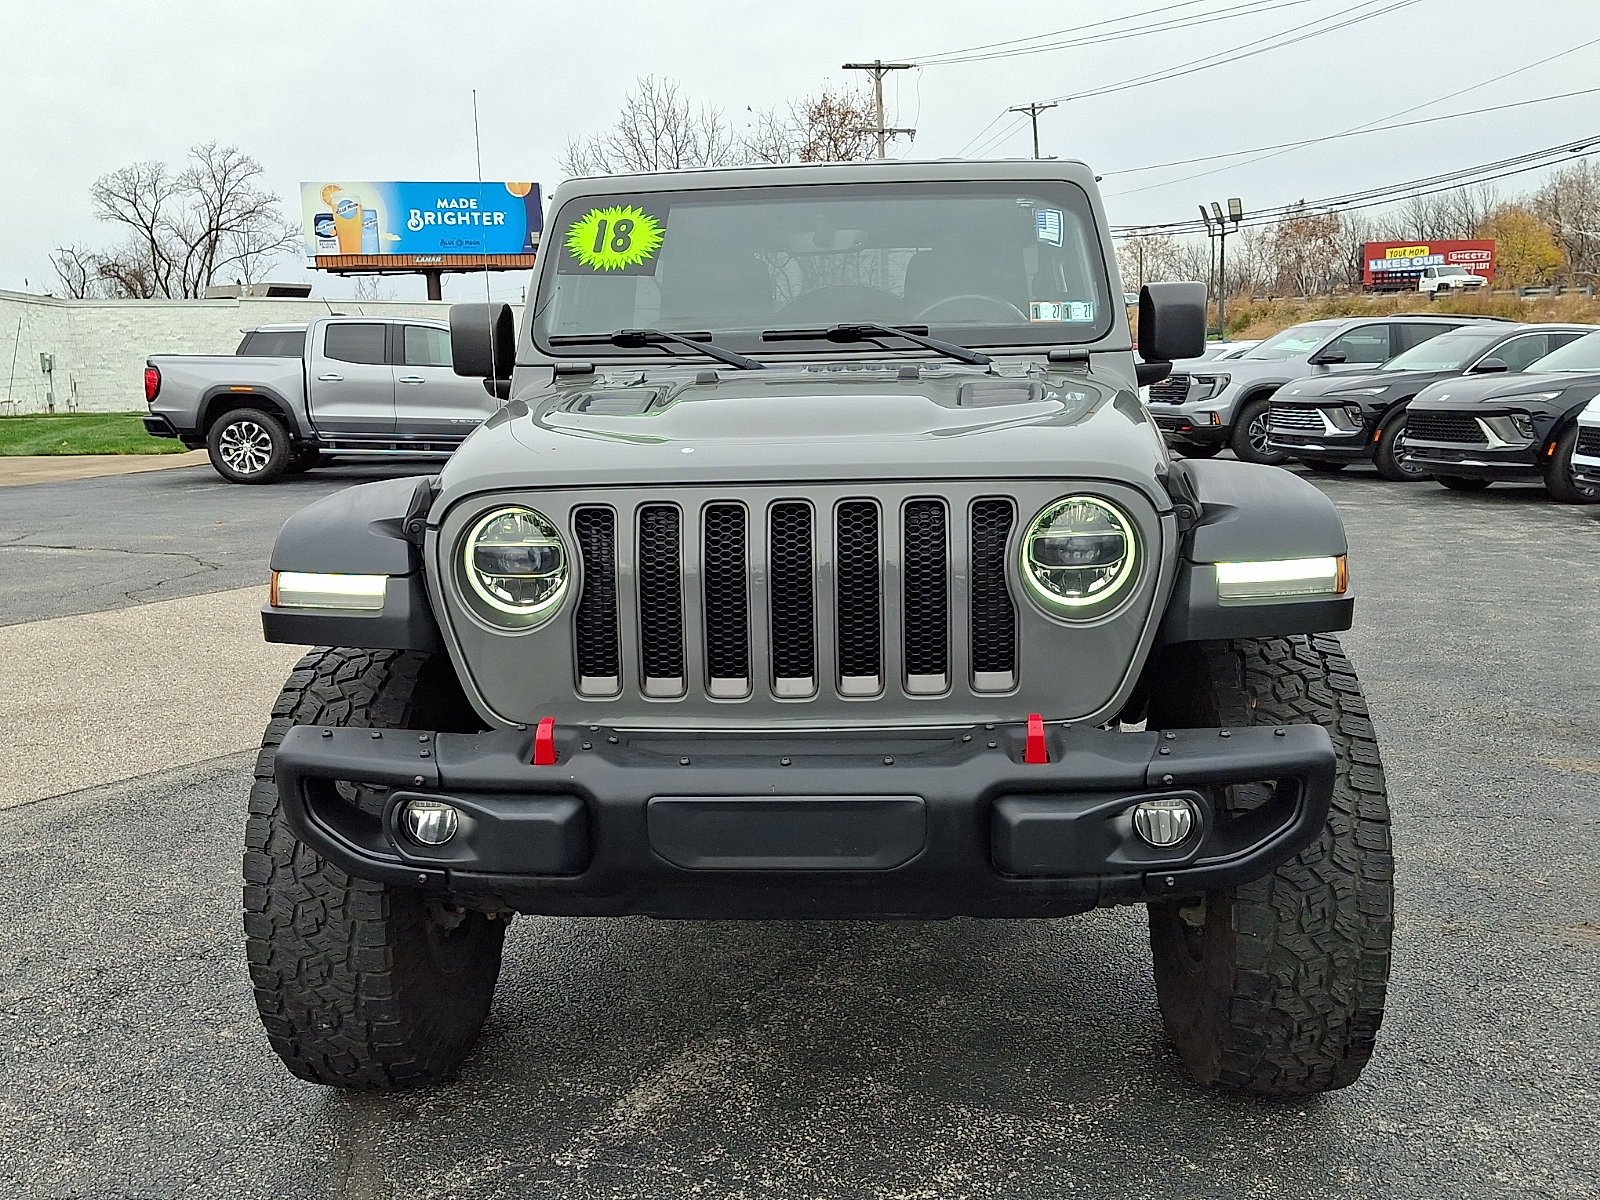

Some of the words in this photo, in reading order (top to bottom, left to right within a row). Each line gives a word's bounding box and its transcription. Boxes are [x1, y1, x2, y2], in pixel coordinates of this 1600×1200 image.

[437, 197, 478, 209] MADE
[407, 209, 505, 232] BRIGHTER
[440, 238, 455, 246] BLUE
[592, 219, 635, 253] 18
[1389, 249, 1406, 258] YOUR
[1408, 247, 1426, 256] MOM
[1451, 252, 1488, 260] SHEETZ
[1369, 258, 1411, 270] LIKES
[1412, 254, 1444, 266] OUR
[1476, 262, 1490, 270] LEFT
[1052, 304, 1060, 319] 27
[1084, 304, 1091, 318] 27
